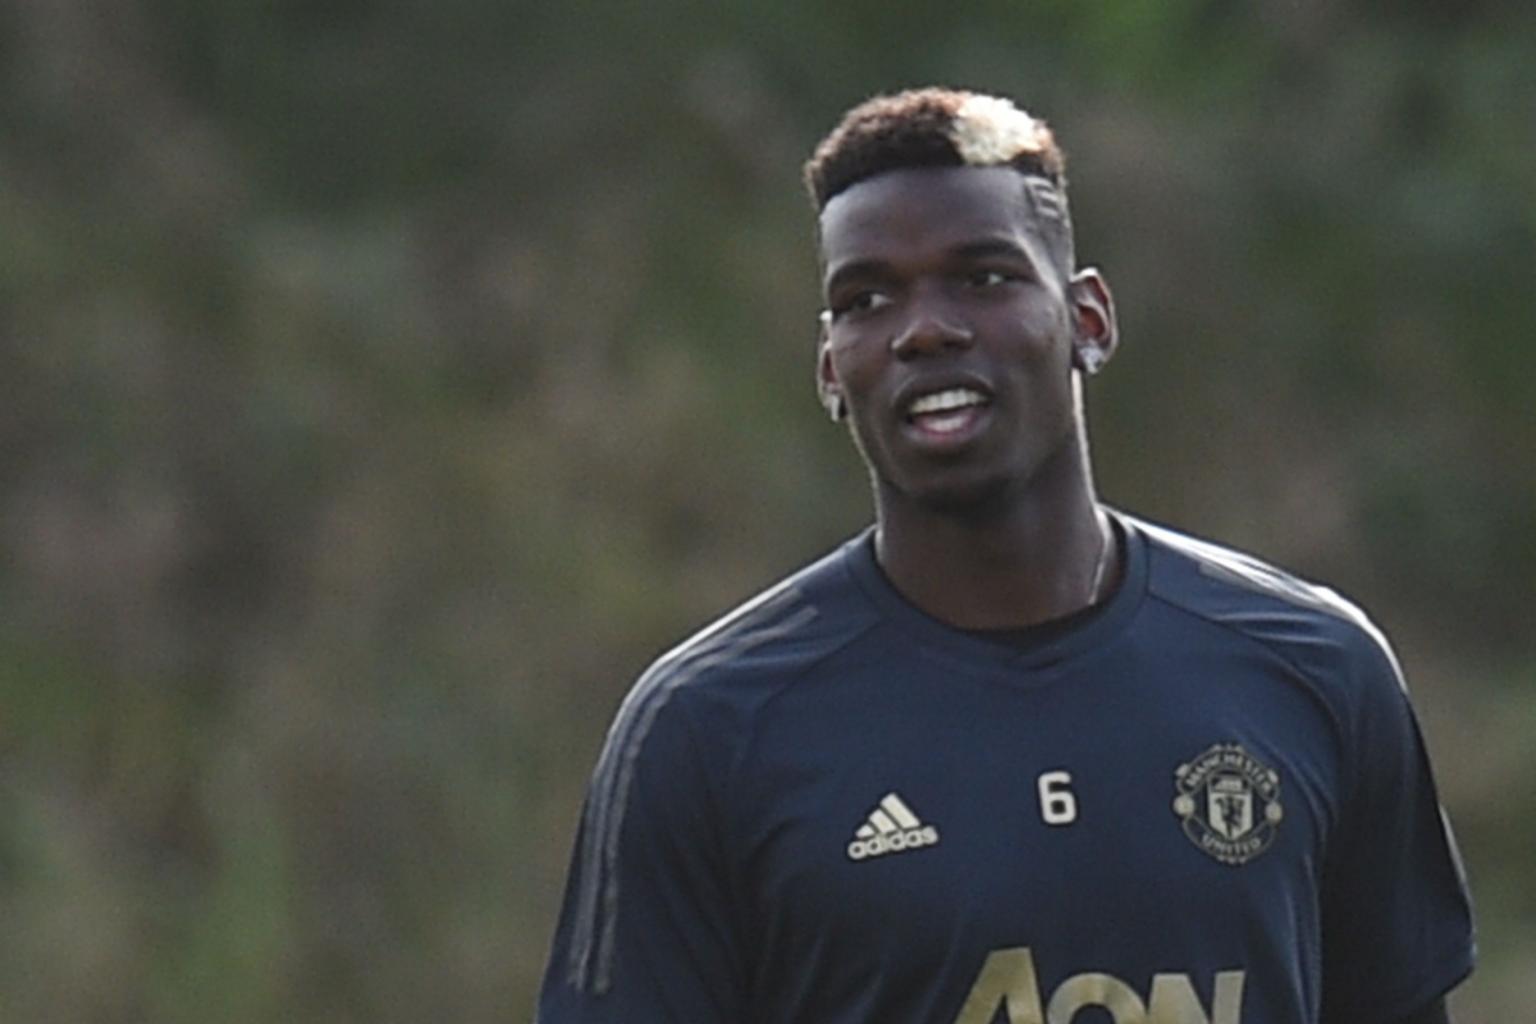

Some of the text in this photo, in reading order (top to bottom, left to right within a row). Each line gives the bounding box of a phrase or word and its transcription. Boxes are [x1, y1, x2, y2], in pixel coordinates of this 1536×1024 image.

[1038, 771, 1077, 825] 6
[848, 826, 938, 859] adidas
[1202, 833, 1261, 854] UNITED
